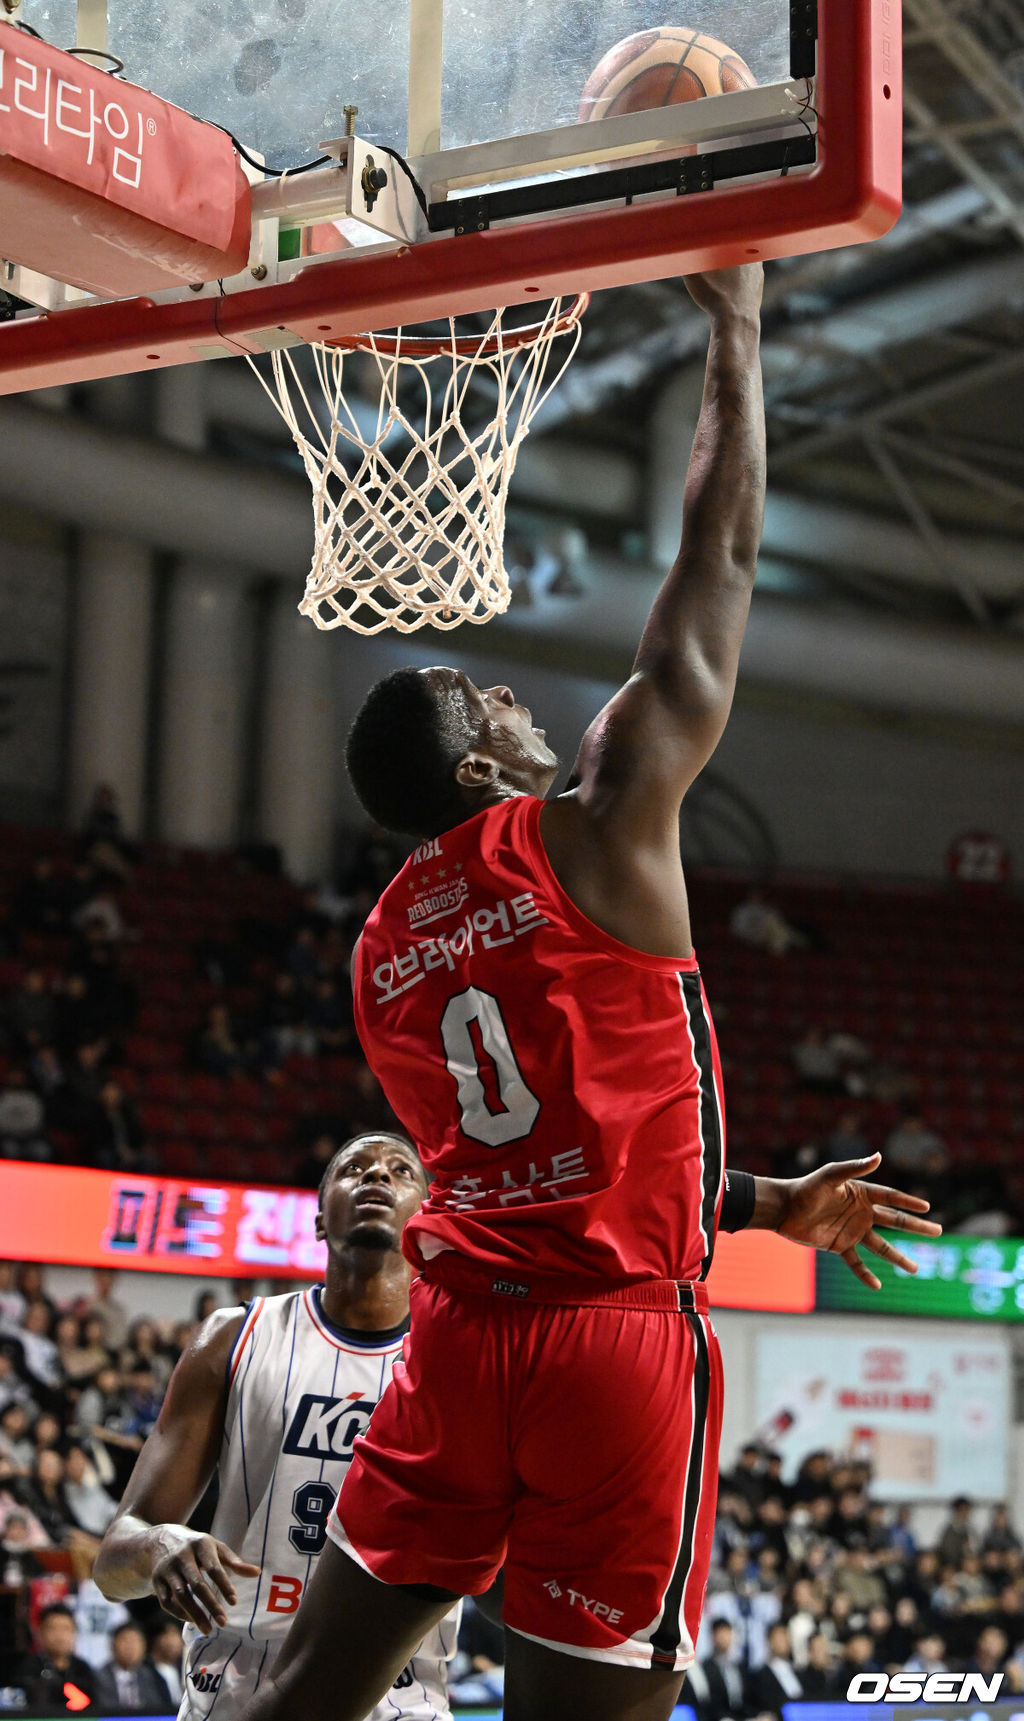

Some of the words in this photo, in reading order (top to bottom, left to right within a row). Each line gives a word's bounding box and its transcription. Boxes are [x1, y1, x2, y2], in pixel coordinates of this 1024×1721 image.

[0, 49, 143, 189] 리타임
[413, 837, 443, 866] KBL
[372, 892, 549, 1005] 오브라이언트
[440, 985, 541, 1147] 0
[266, 1575, 311, 1614] B
[567, 1588, 624, 1624] TYPE
